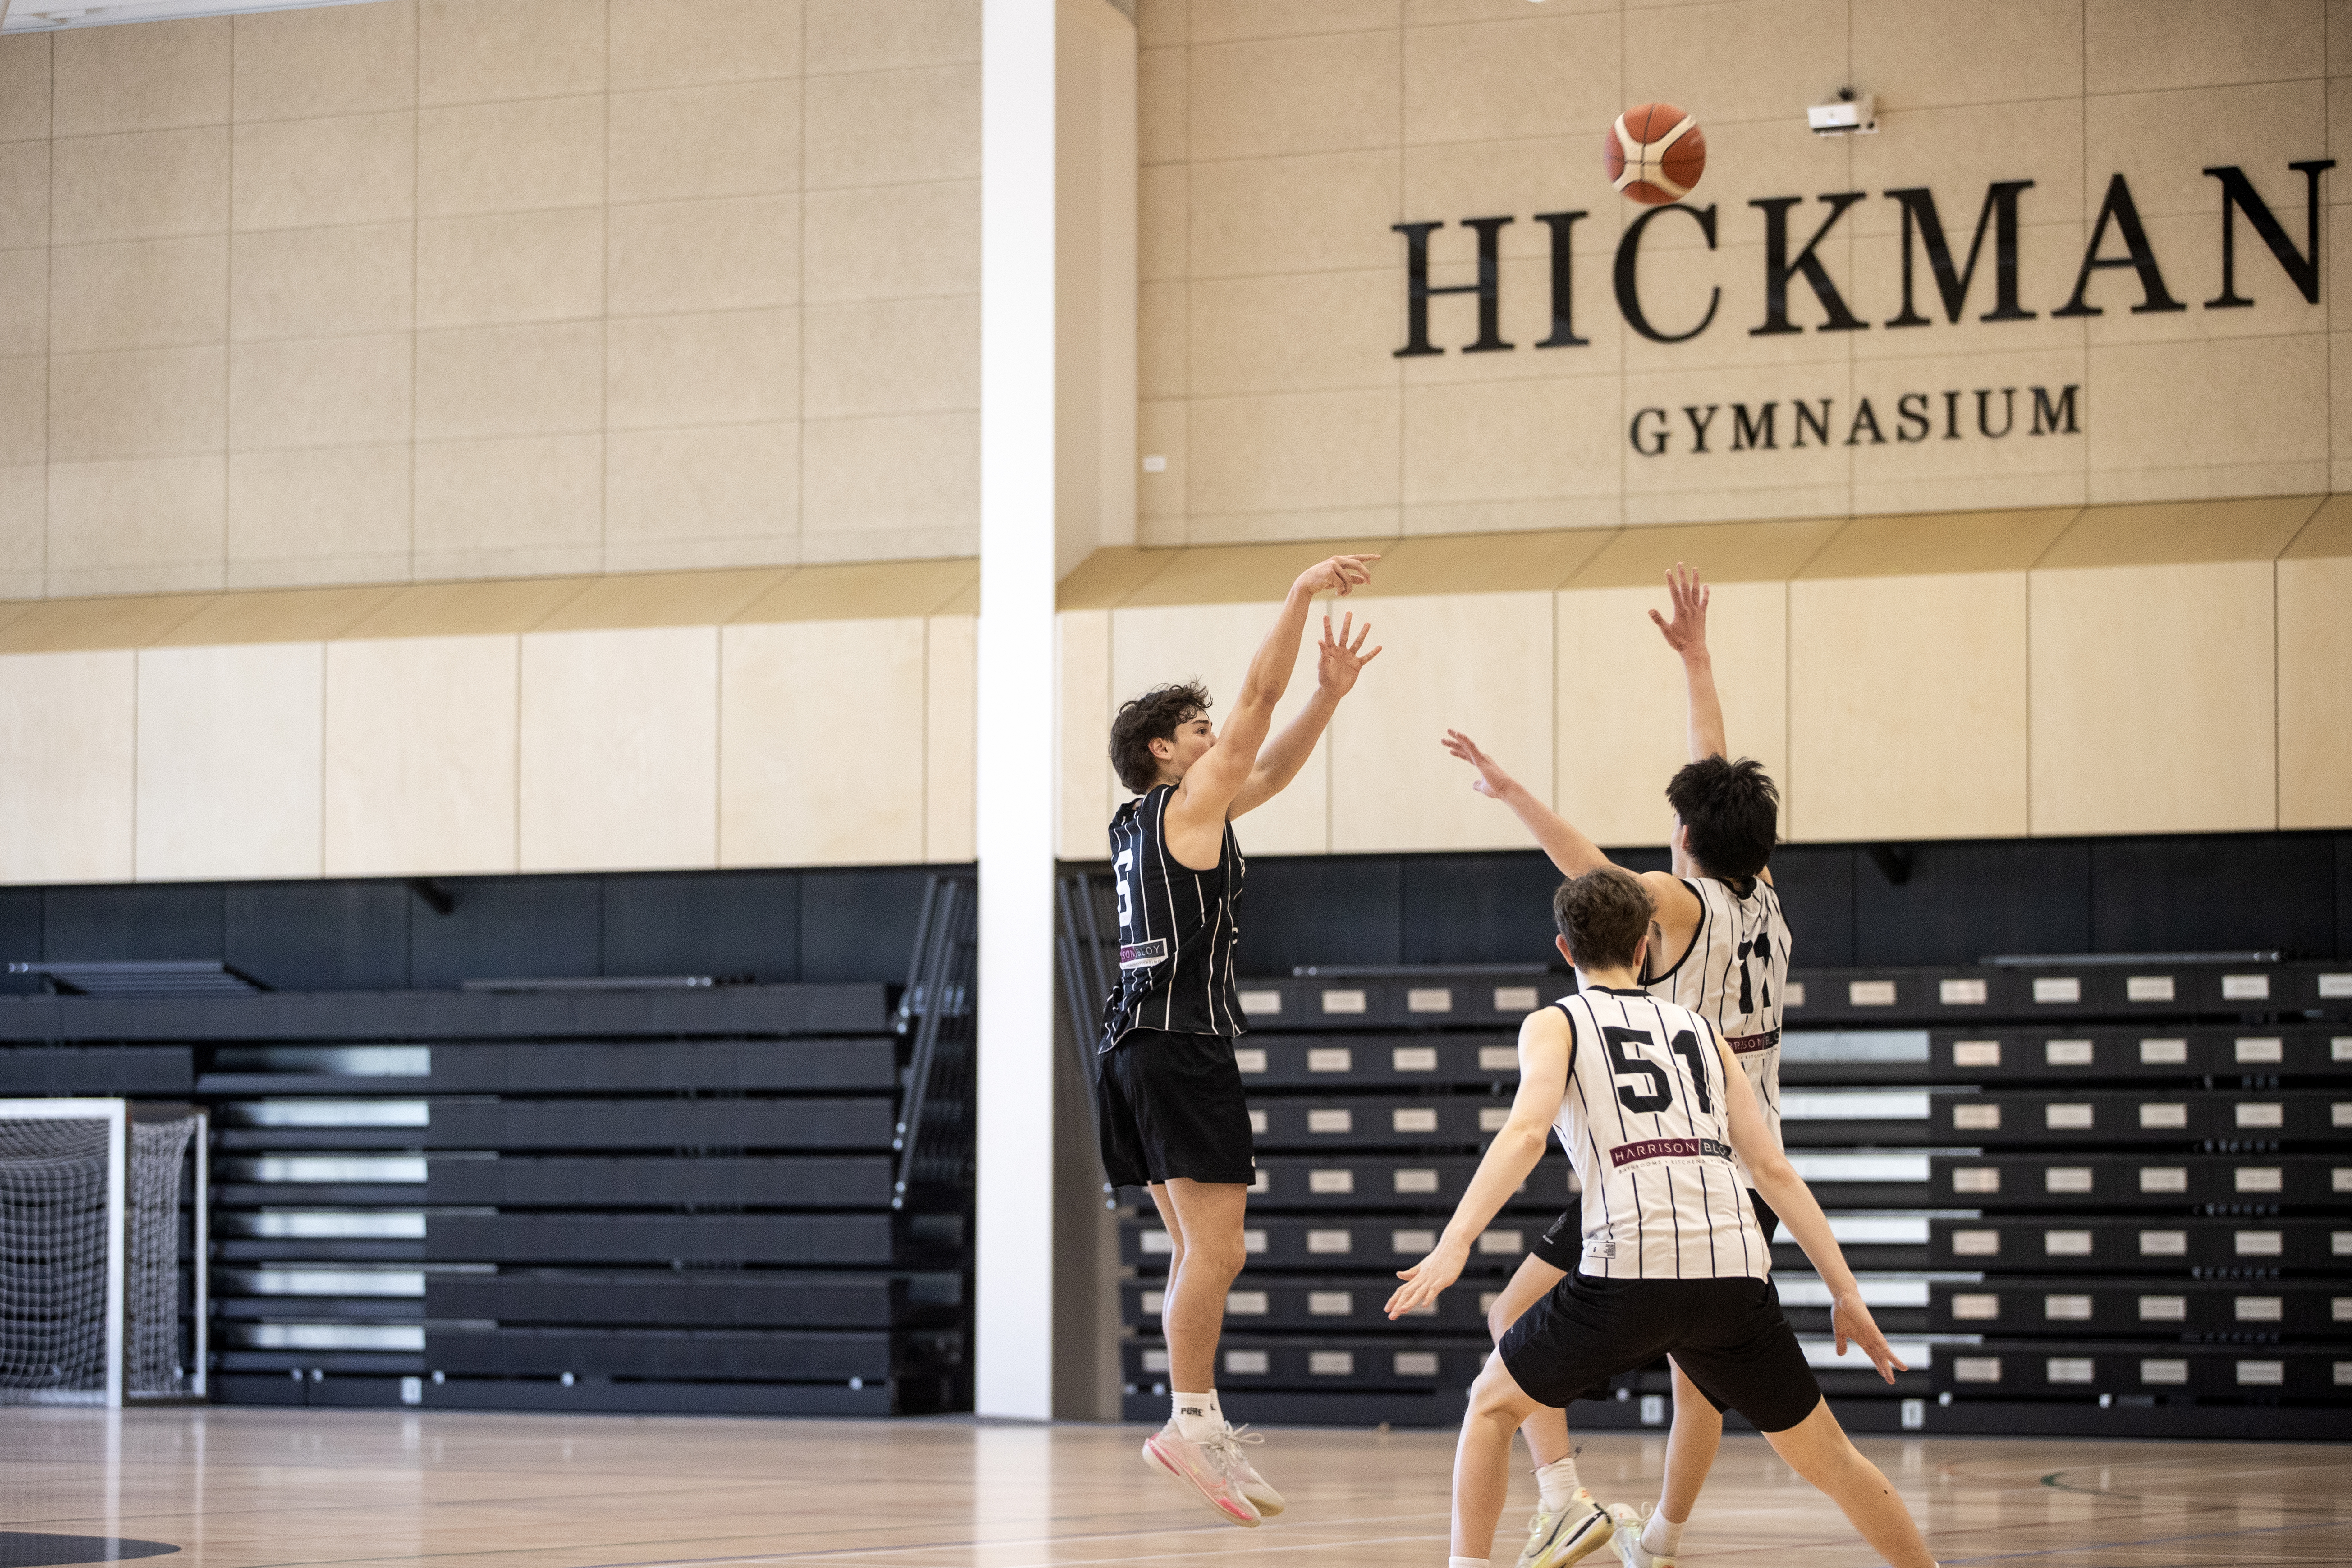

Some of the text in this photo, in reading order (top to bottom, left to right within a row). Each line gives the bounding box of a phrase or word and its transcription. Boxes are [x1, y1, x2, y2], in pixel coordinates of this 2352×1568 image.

[1392, 160, 2338, 358] HICKMAN
[1629, 384, 2080, 455] GYMNASIUM
[1136, 945, 1160, 957] BLOY
[1602, 1026, 1711, 1114] 51
[1615, 1142, 1696, 1162] HARRISON
